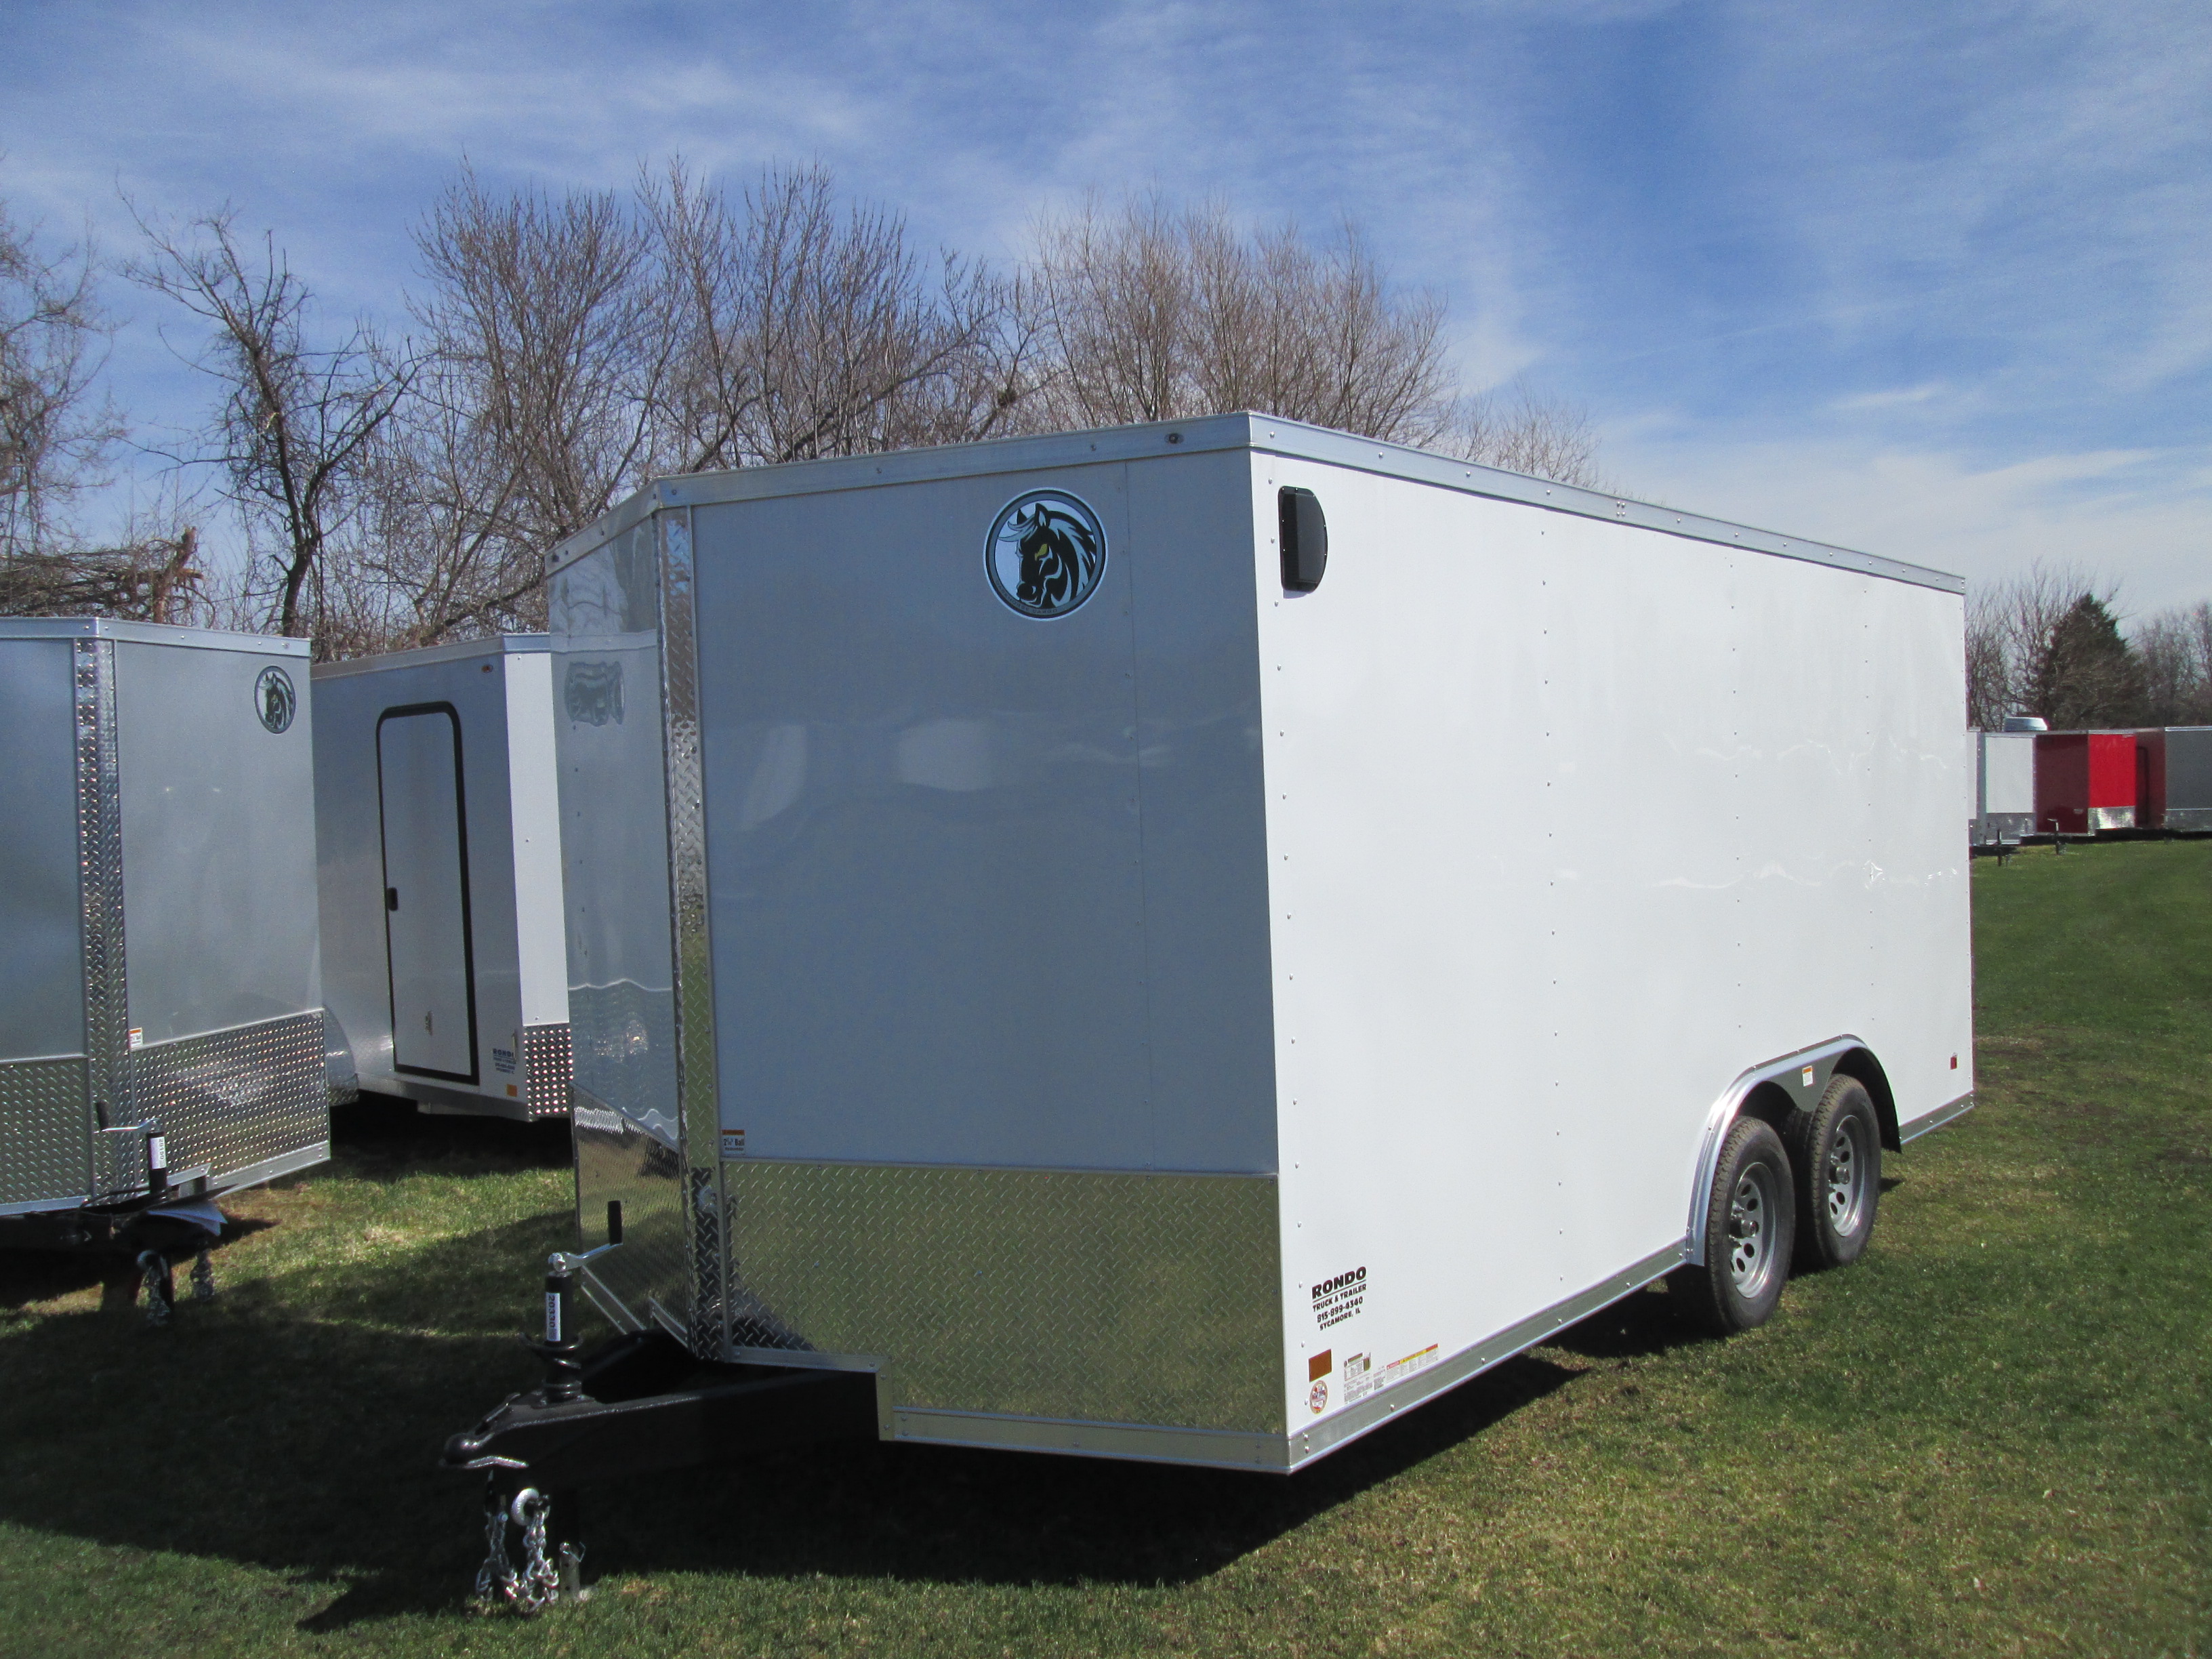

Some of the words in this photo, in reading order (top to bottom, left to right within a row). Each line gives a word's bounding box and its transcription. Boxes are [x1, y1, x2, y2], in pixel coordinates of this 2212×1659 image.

[1312, 1266, 1366, 1299] RONDO
[1313, 1297, 1333, 1312] TRUCK
[1340, 1284, 1366, 1300] TRAILER
[1317, 1296, 1363, 1323] 815-899-4340
[1319, 1311, 1353, 1331] SYCAMORE,
